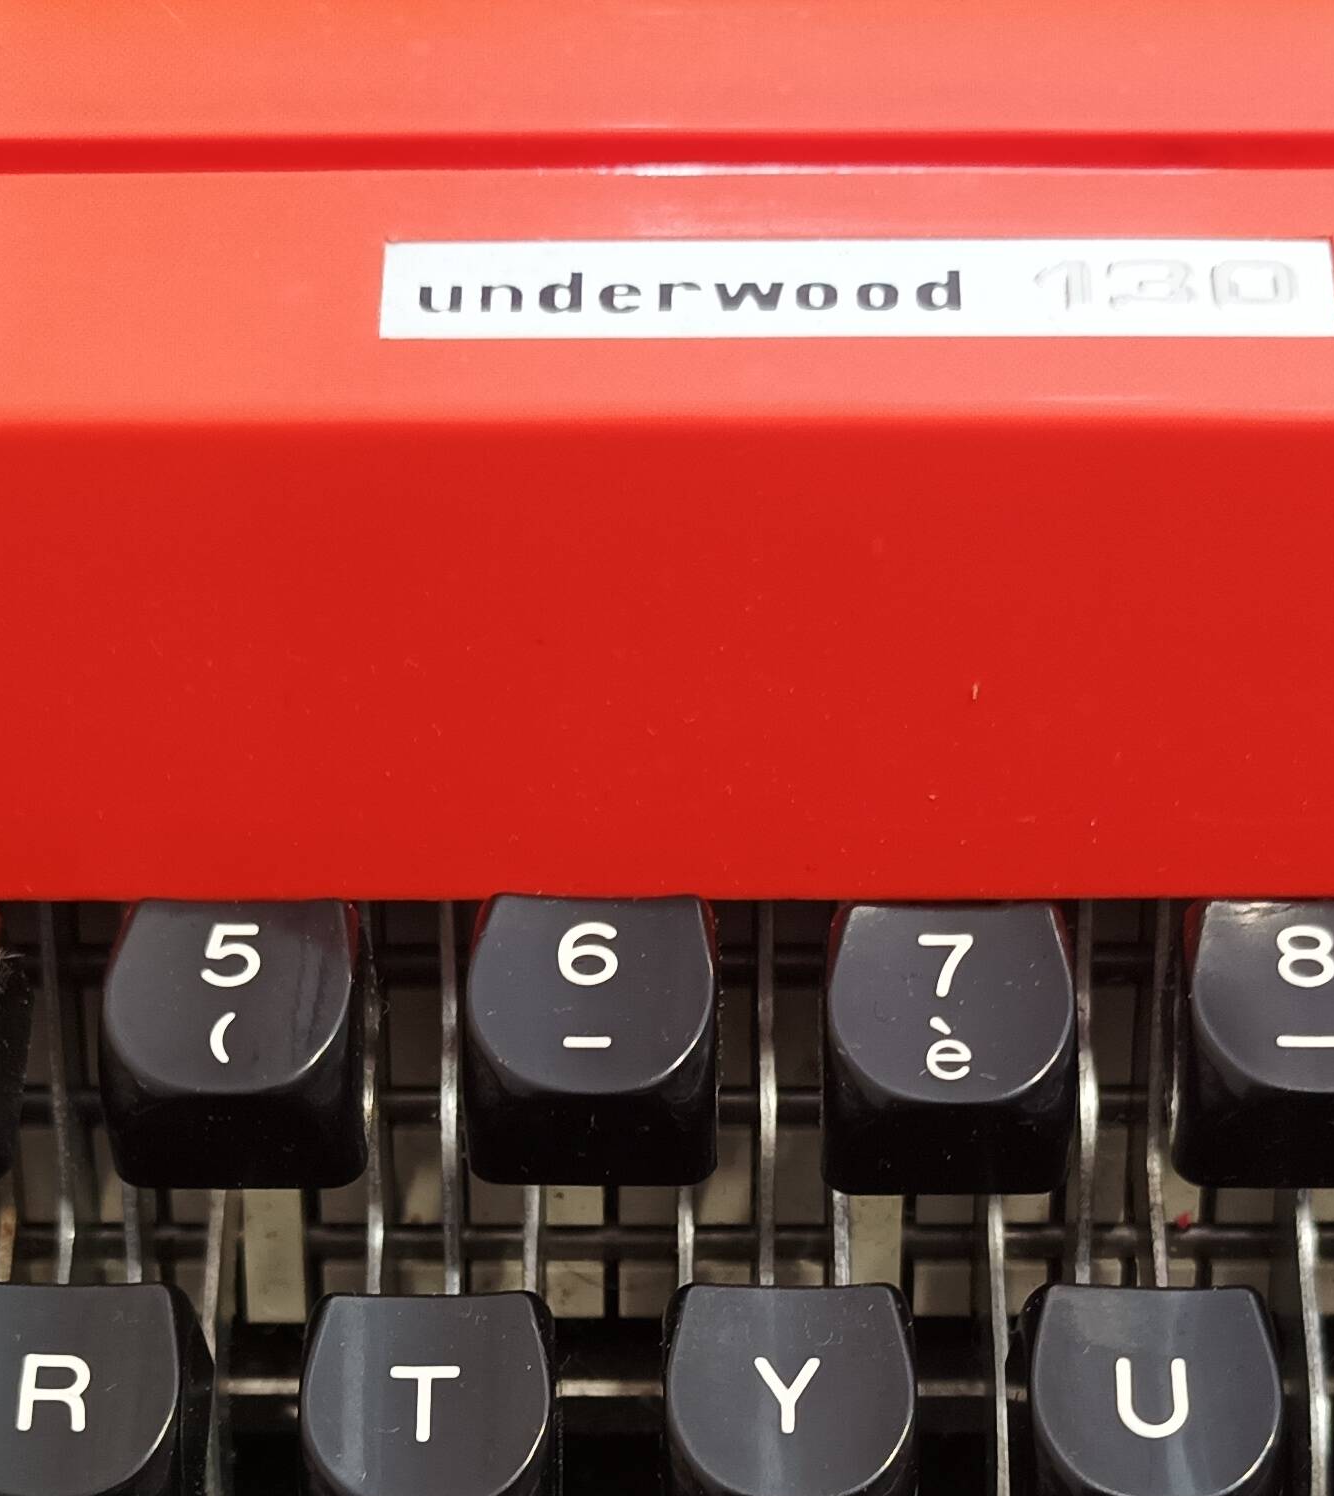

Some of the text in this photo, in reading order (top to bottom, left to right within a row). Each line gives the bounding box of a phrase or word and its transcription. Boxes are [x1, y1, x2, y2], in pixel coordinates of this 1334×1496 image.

[417, 259, 1301, 314] underwood 130
[199, 922, 262, 989] 5
[556, 920, 620, 987] 6
[916, 932, 975, 999] 7
[208, 1010, 237, 1065] (
[925, 1015, 973, 1082] è
[15, 1352, 92, 1433] R
[388, 1364, 462, 1444] T
[752, 1355, 822, 1435] Y
[1114, 1356, 1190, 1440] U
